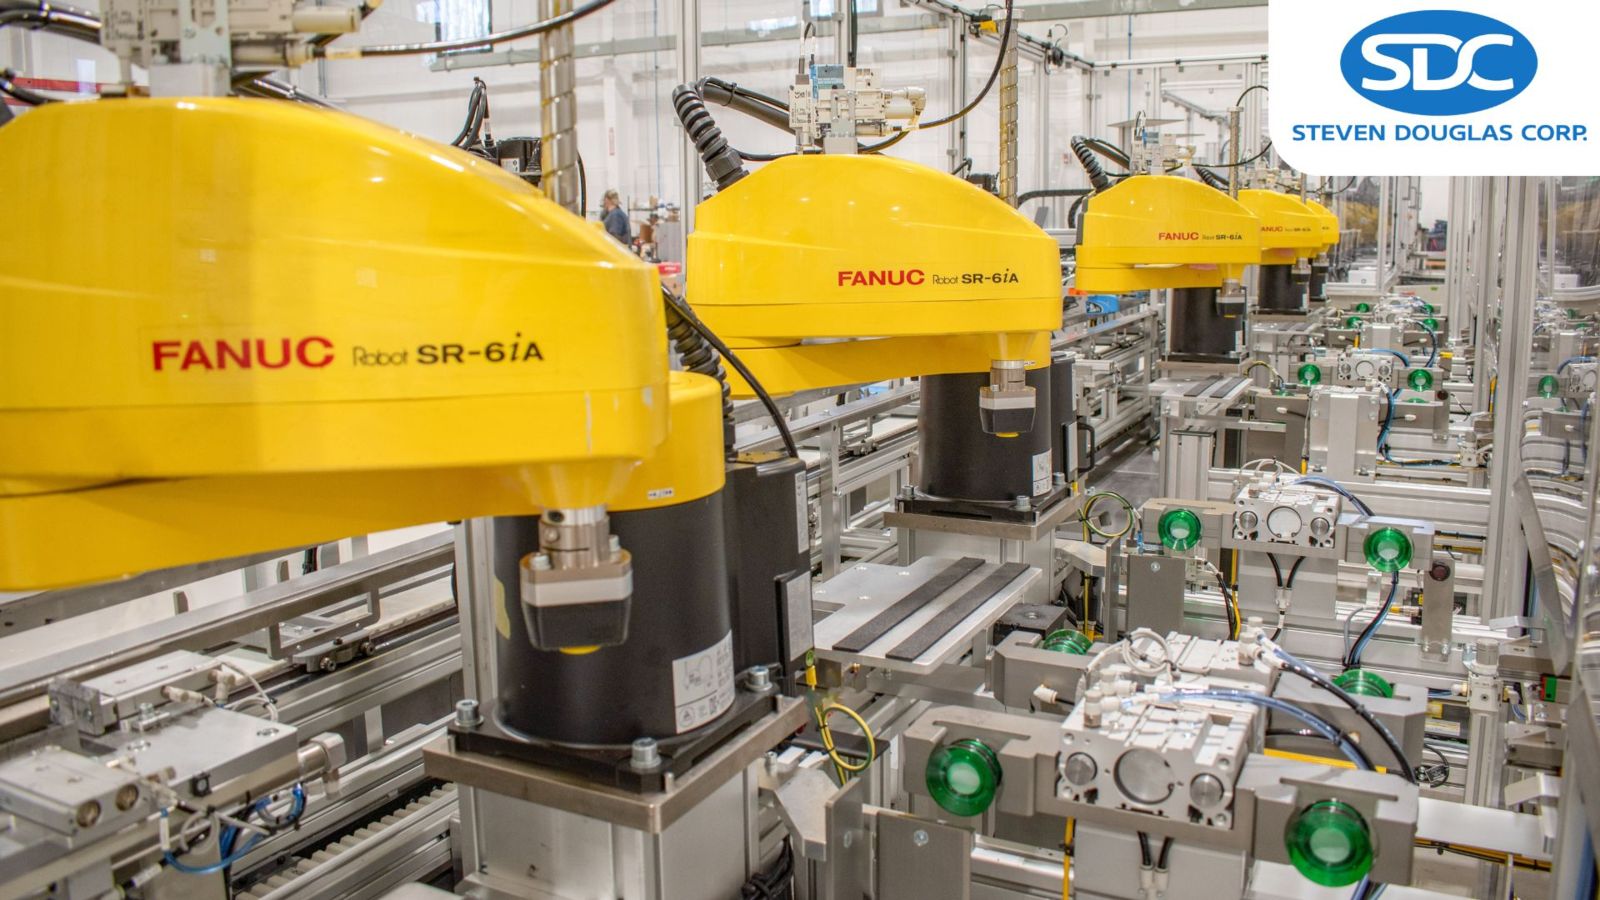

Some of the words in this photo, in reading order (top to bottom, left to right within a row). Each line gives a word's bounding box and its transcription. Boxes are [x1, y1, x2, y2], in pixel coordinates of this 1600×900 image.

[1158, 231, 1199, 241] FANUC
[1260, 225, 1283, 233] ANUC
[837, 269, 926, 287] FANUC
[932, 274, 959, 285] Robot
[961, 268, 1019, 284] SR-6iA
[151, 336, 335, 371] FANUC
[352, 346, 409, 366] Robot
[416, 332, 545, 365] SR-6iA
